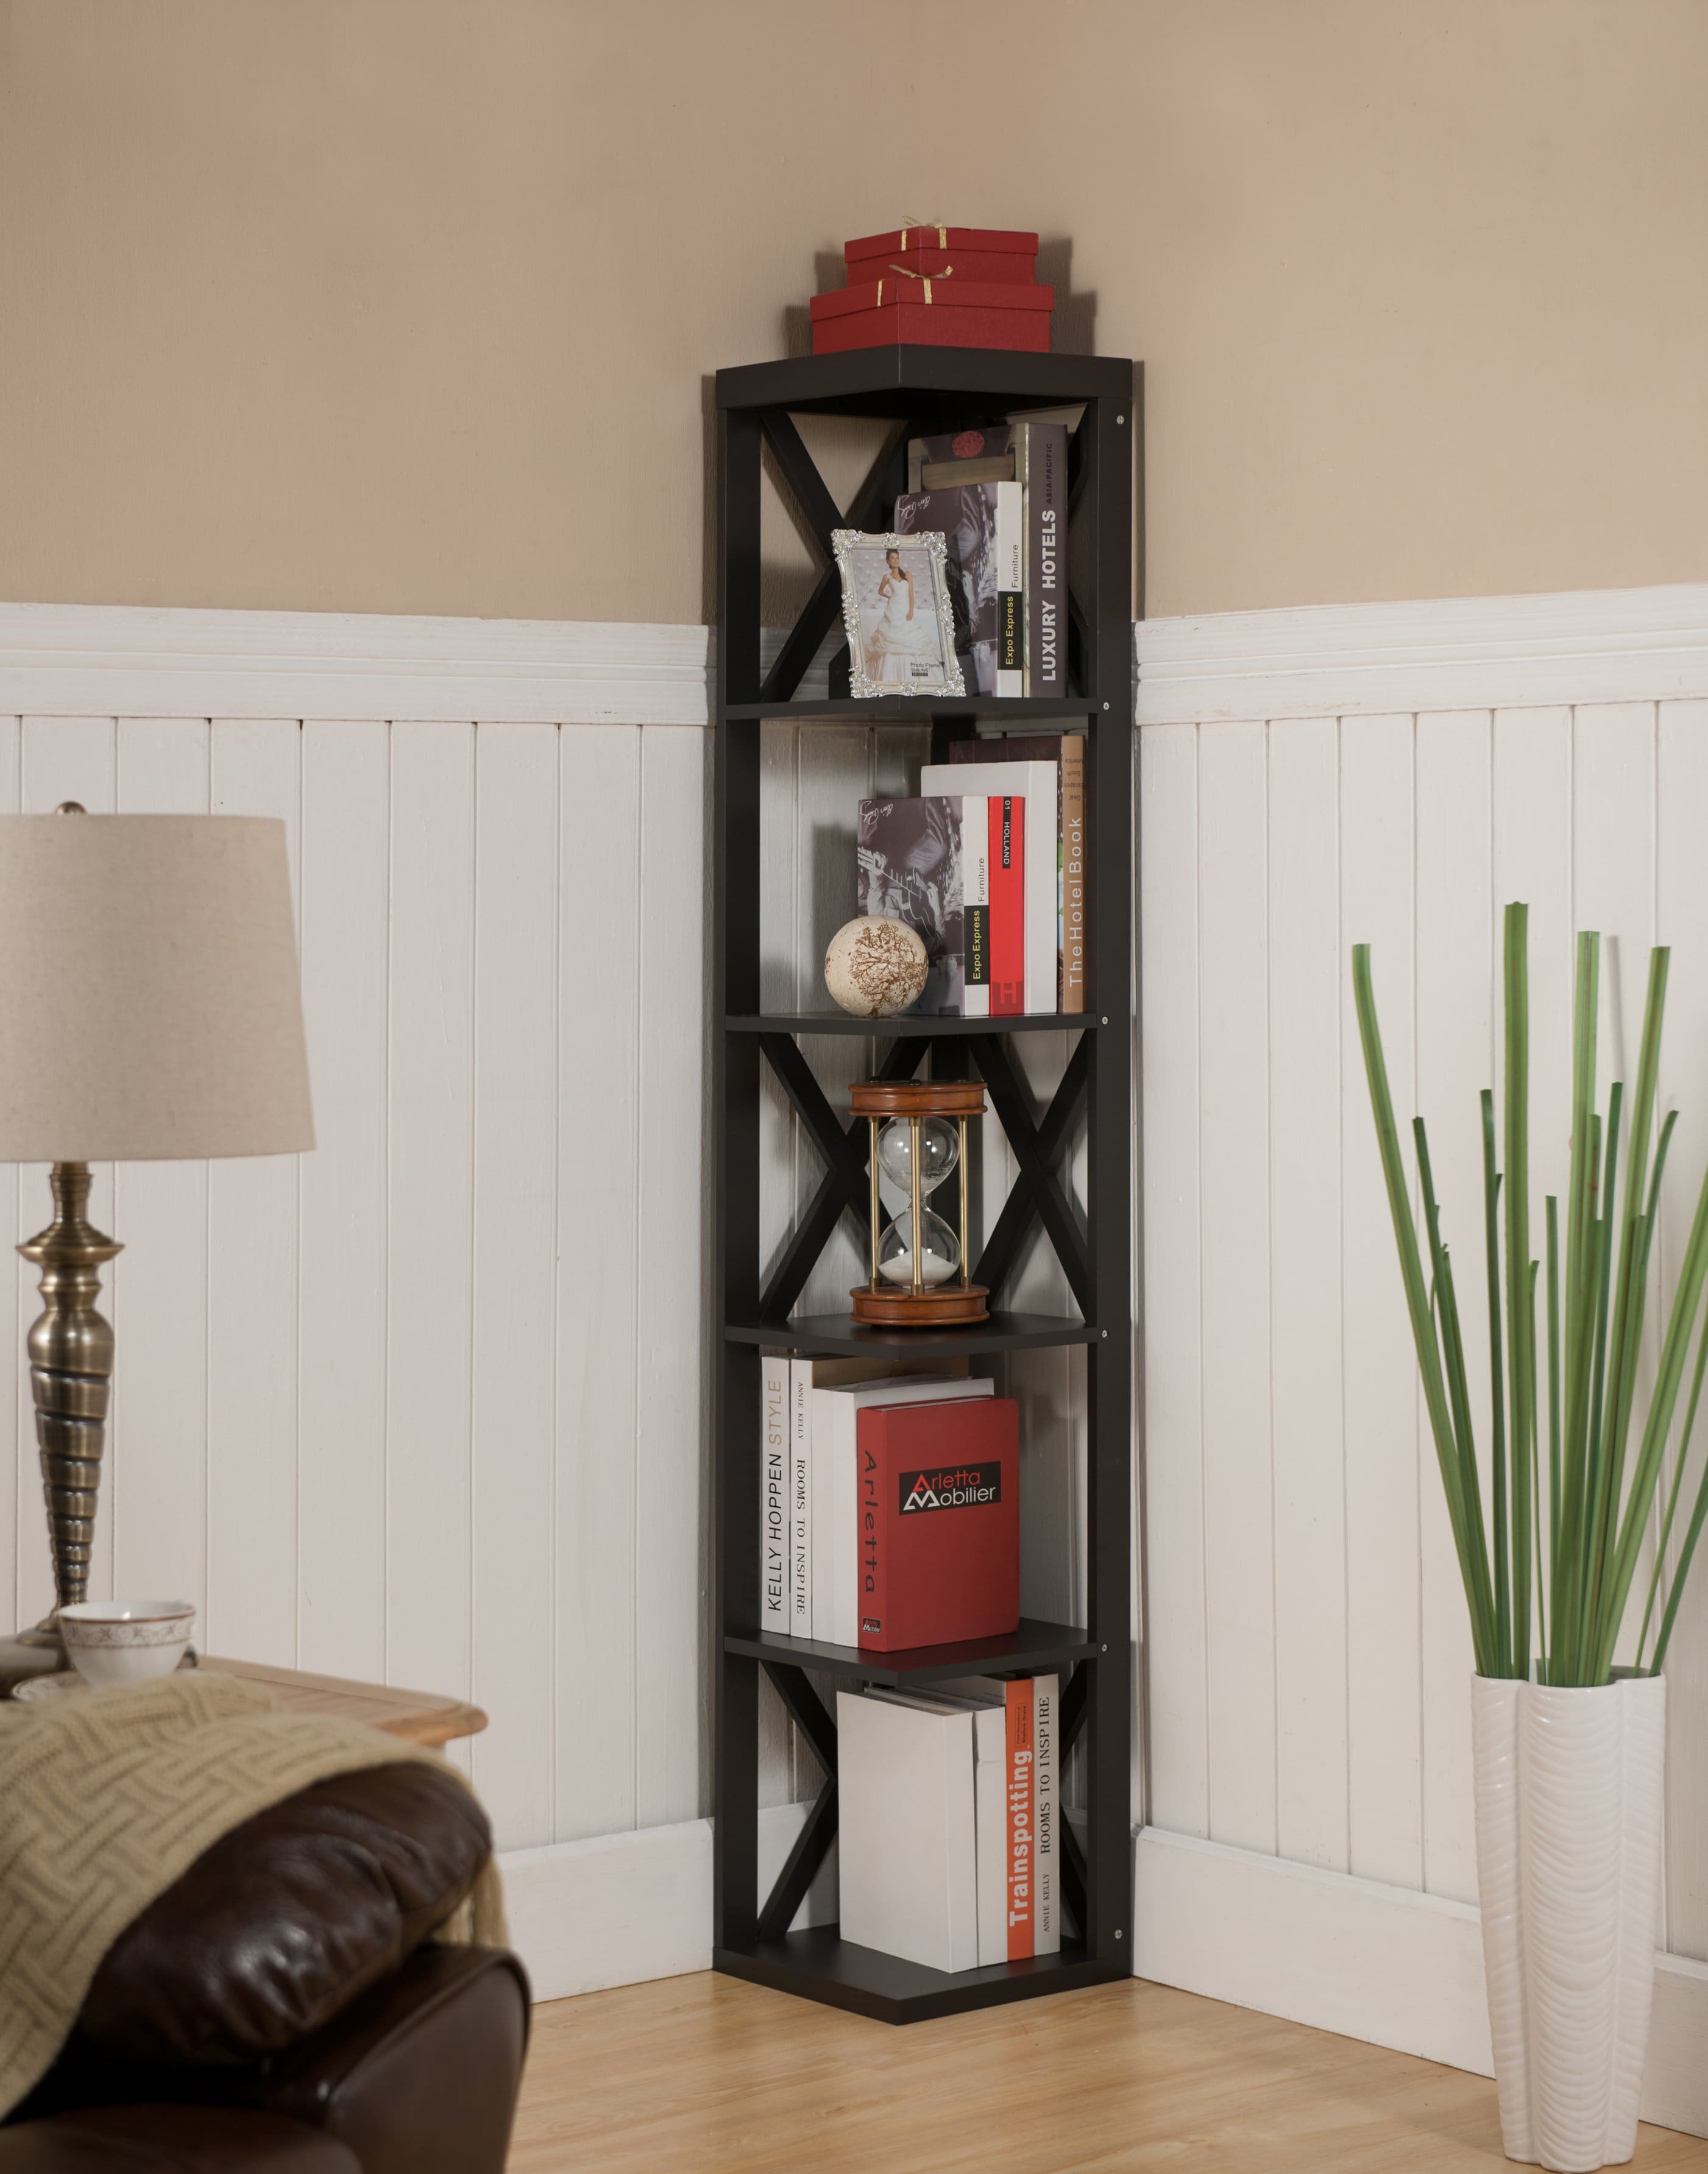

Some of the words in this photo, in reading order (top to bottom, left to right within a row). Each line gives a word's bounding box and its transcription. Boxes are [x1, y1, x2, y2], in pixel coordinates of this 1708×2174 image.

[1041, 510, 1056, 588] HOTELS
[1005, 597, 1015, 637] Express
[1042, 600, 1056, 681] LUXURY
[1005, 640, 1015, 664] Expo
[1005, 800, 1010, 810] 01
[1069, 818, 1081, 873] Book
[972, 910, 981, 951] Express
[1069, 880, 1082, 940] Hotel
[973, 954, 982, 979] Expo
[1070, 946, 1082, 987] The
[768, 1380, 781, 1445] STYLE
[768, 1454, 781, 1540] HOPPEN
[796, 1459, 806, 1510] ROOMS
[903, 1486, 996, 1510] Mobilier
[912, 1470, 980, 1492] Arletta
[796, 1518, 805, 1538] TO
[864, 1450, 877, 1592] Arletta
[768, 1548, 781, 1611] KELLY
[796, 1545, 806, 1614] INSPIRE
[1039, 1697, 1049, 1766] INSPIRE
[1040, 1775, 1050, 1795] TO
[1009, 1750, 1032, 1926] Trainspotting
[1040, 1802, 1050, 1854] ROOMS
